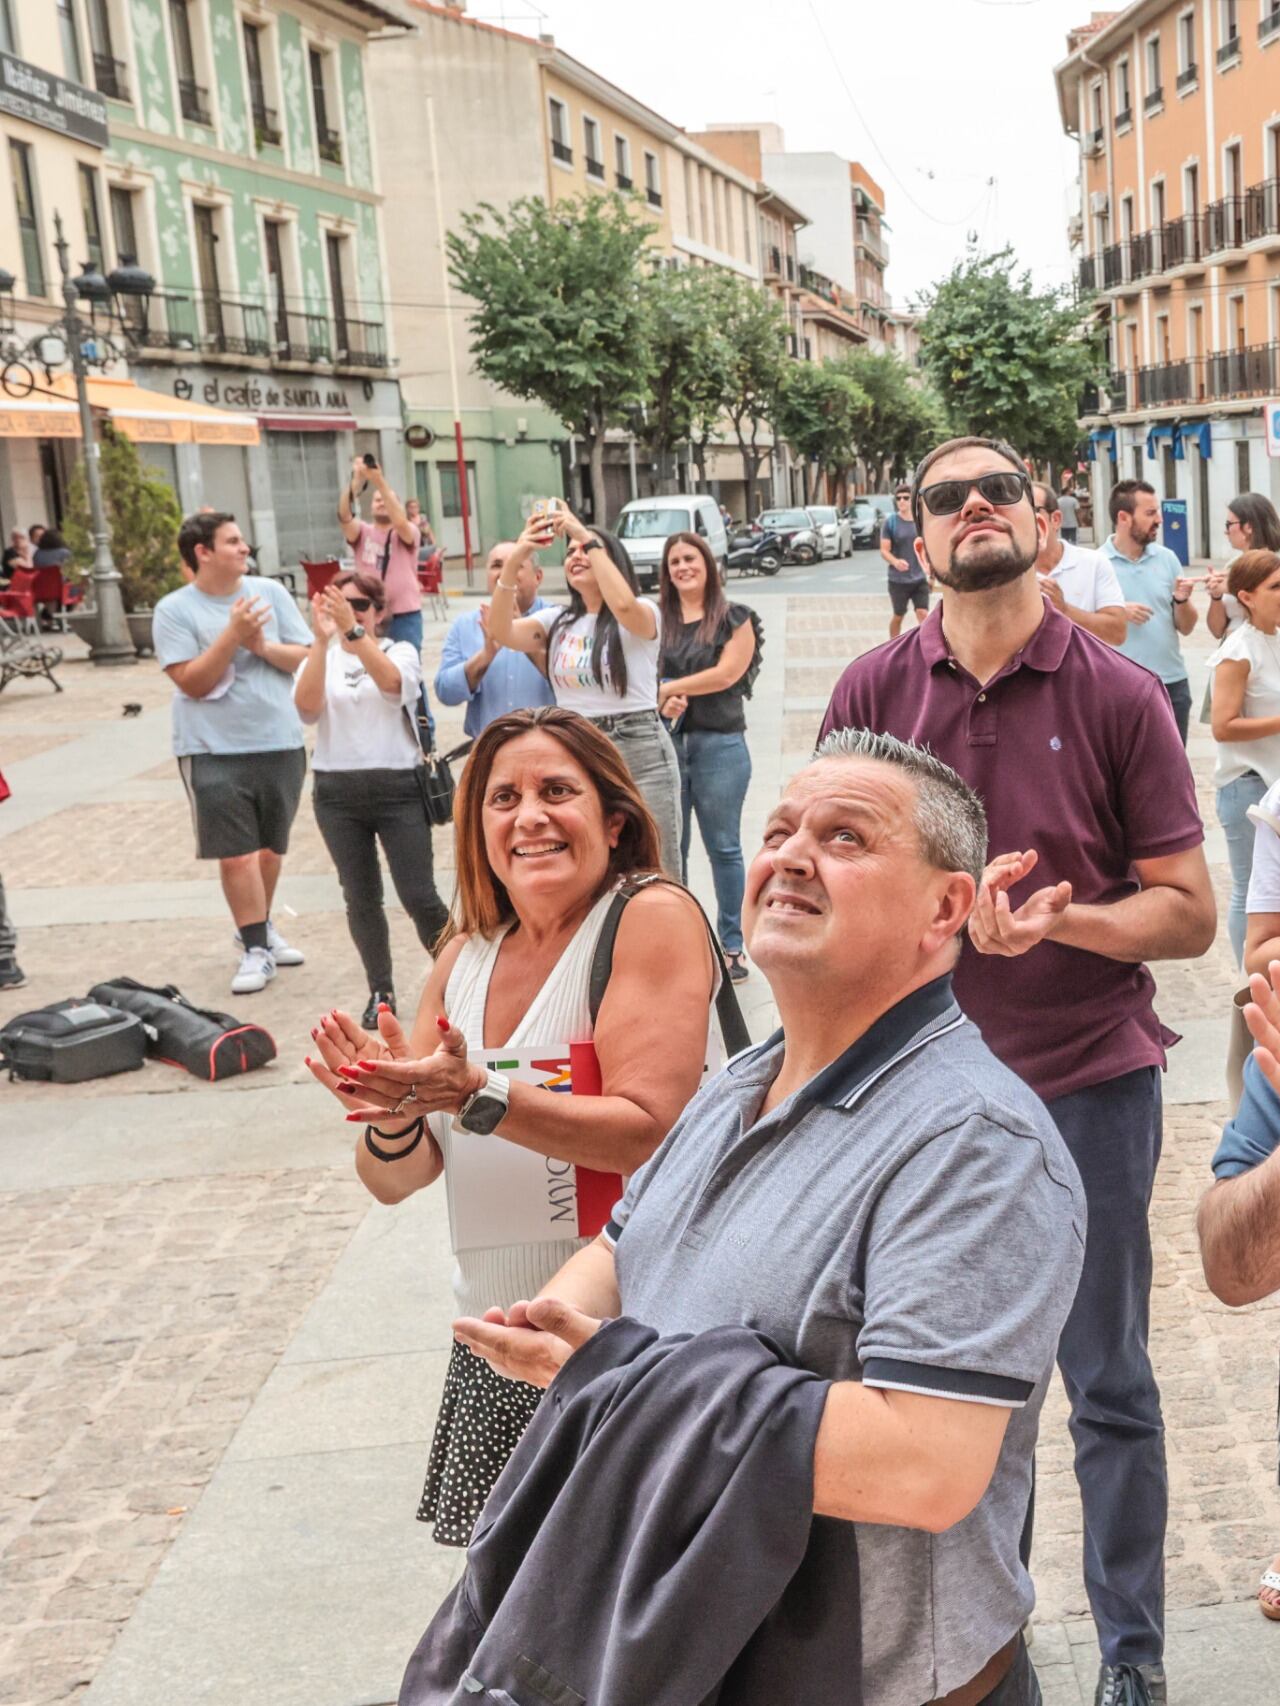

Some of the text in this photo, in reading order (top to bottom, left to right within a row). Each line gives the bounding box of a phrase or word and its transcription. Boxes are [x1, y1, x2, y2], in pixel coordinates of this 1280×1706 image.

[203, 378, 348, 409] el café de SANTA ANA
